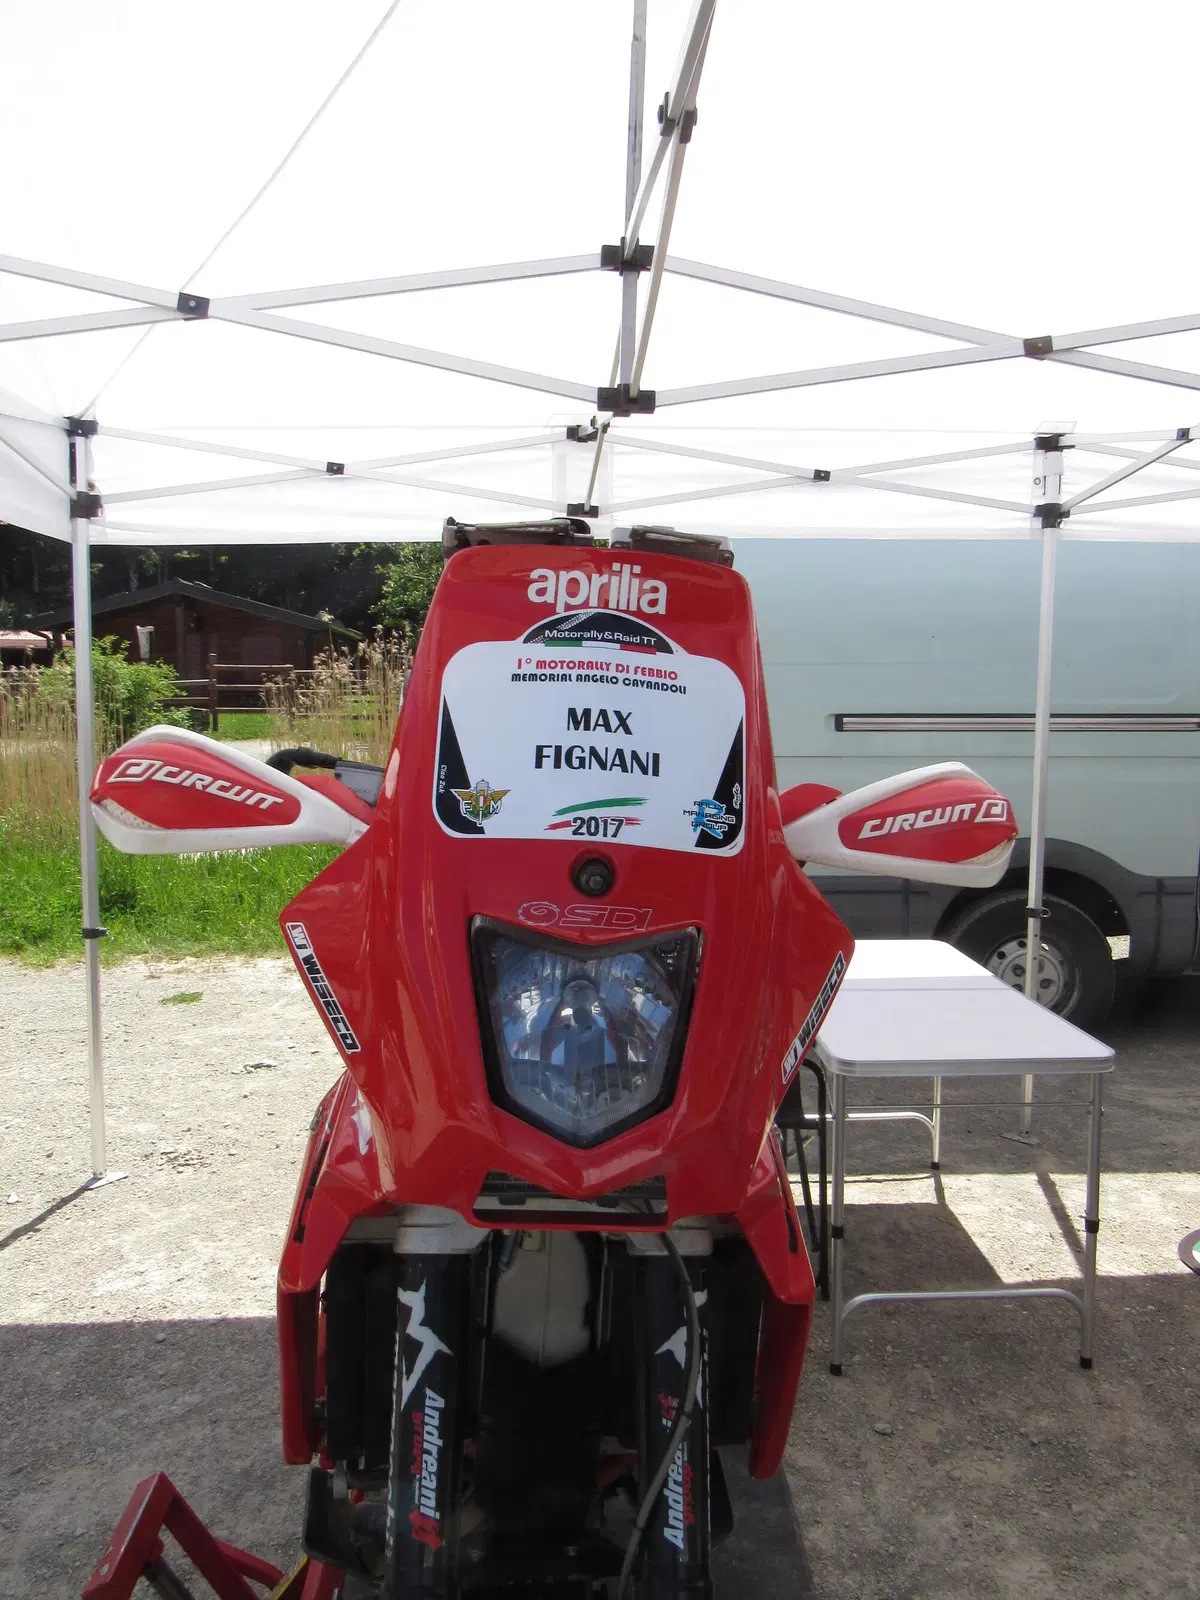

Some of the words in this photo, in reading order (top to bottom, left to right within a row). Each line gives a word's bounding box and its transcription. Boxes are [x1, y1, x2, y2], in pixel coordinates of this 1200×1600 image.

[527, 562, 668, 615] aprilia
[642, 636, 657, 646] TT
[536, 659, 612, 672] MOTORALLY
[615, 663, 630, 675] DI
[634, 665, 679, 681] FEBBIO
[511, 672, 573, 683] MEMORIAL
[575, 673, 620, 686] ANGELO
[622, 678, 687, 695] CAVANDOLI
[566, 707, 634, 736] MAX
[534, 744, 660, 777] FIGNANI
[151, 765, 285, 810] CIRCUIT
[571, 815, 625, 838] 2017
[683, 809, 735, 823] MANAGING
[691, 821, 728, 831] GROUP
[857, 803, 977, 840] CIRCUIT
[419, 1387, 446, 1520] Andreani
